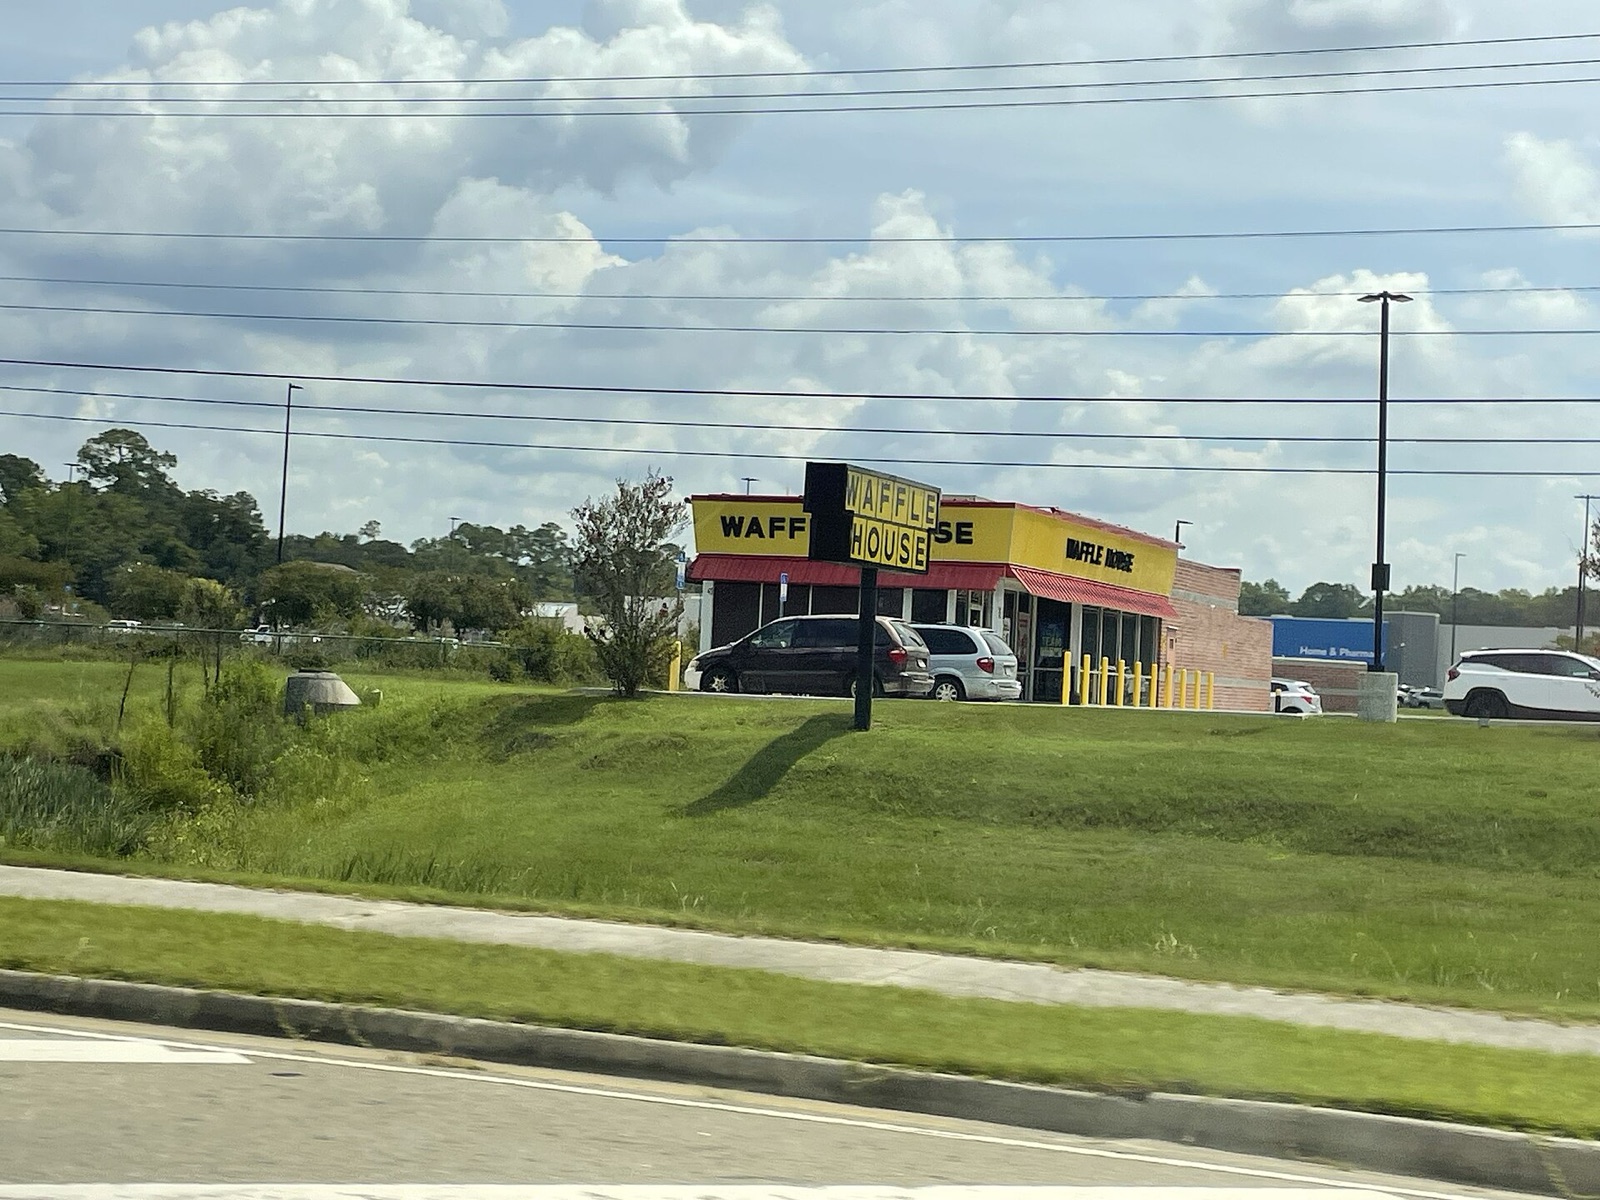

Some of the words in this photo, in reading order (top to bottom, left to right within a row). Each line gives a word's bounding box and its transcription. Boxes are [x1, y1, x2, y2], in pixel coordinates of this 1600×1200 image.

[846, 471, 936, 525] WAFFLE
[720, 514, 807, 540] WAFF
[852, 517, 926, 569] HOUSE
[1299, 646, 1328, 657] Home
[1328, 646, 1337, 657] &
